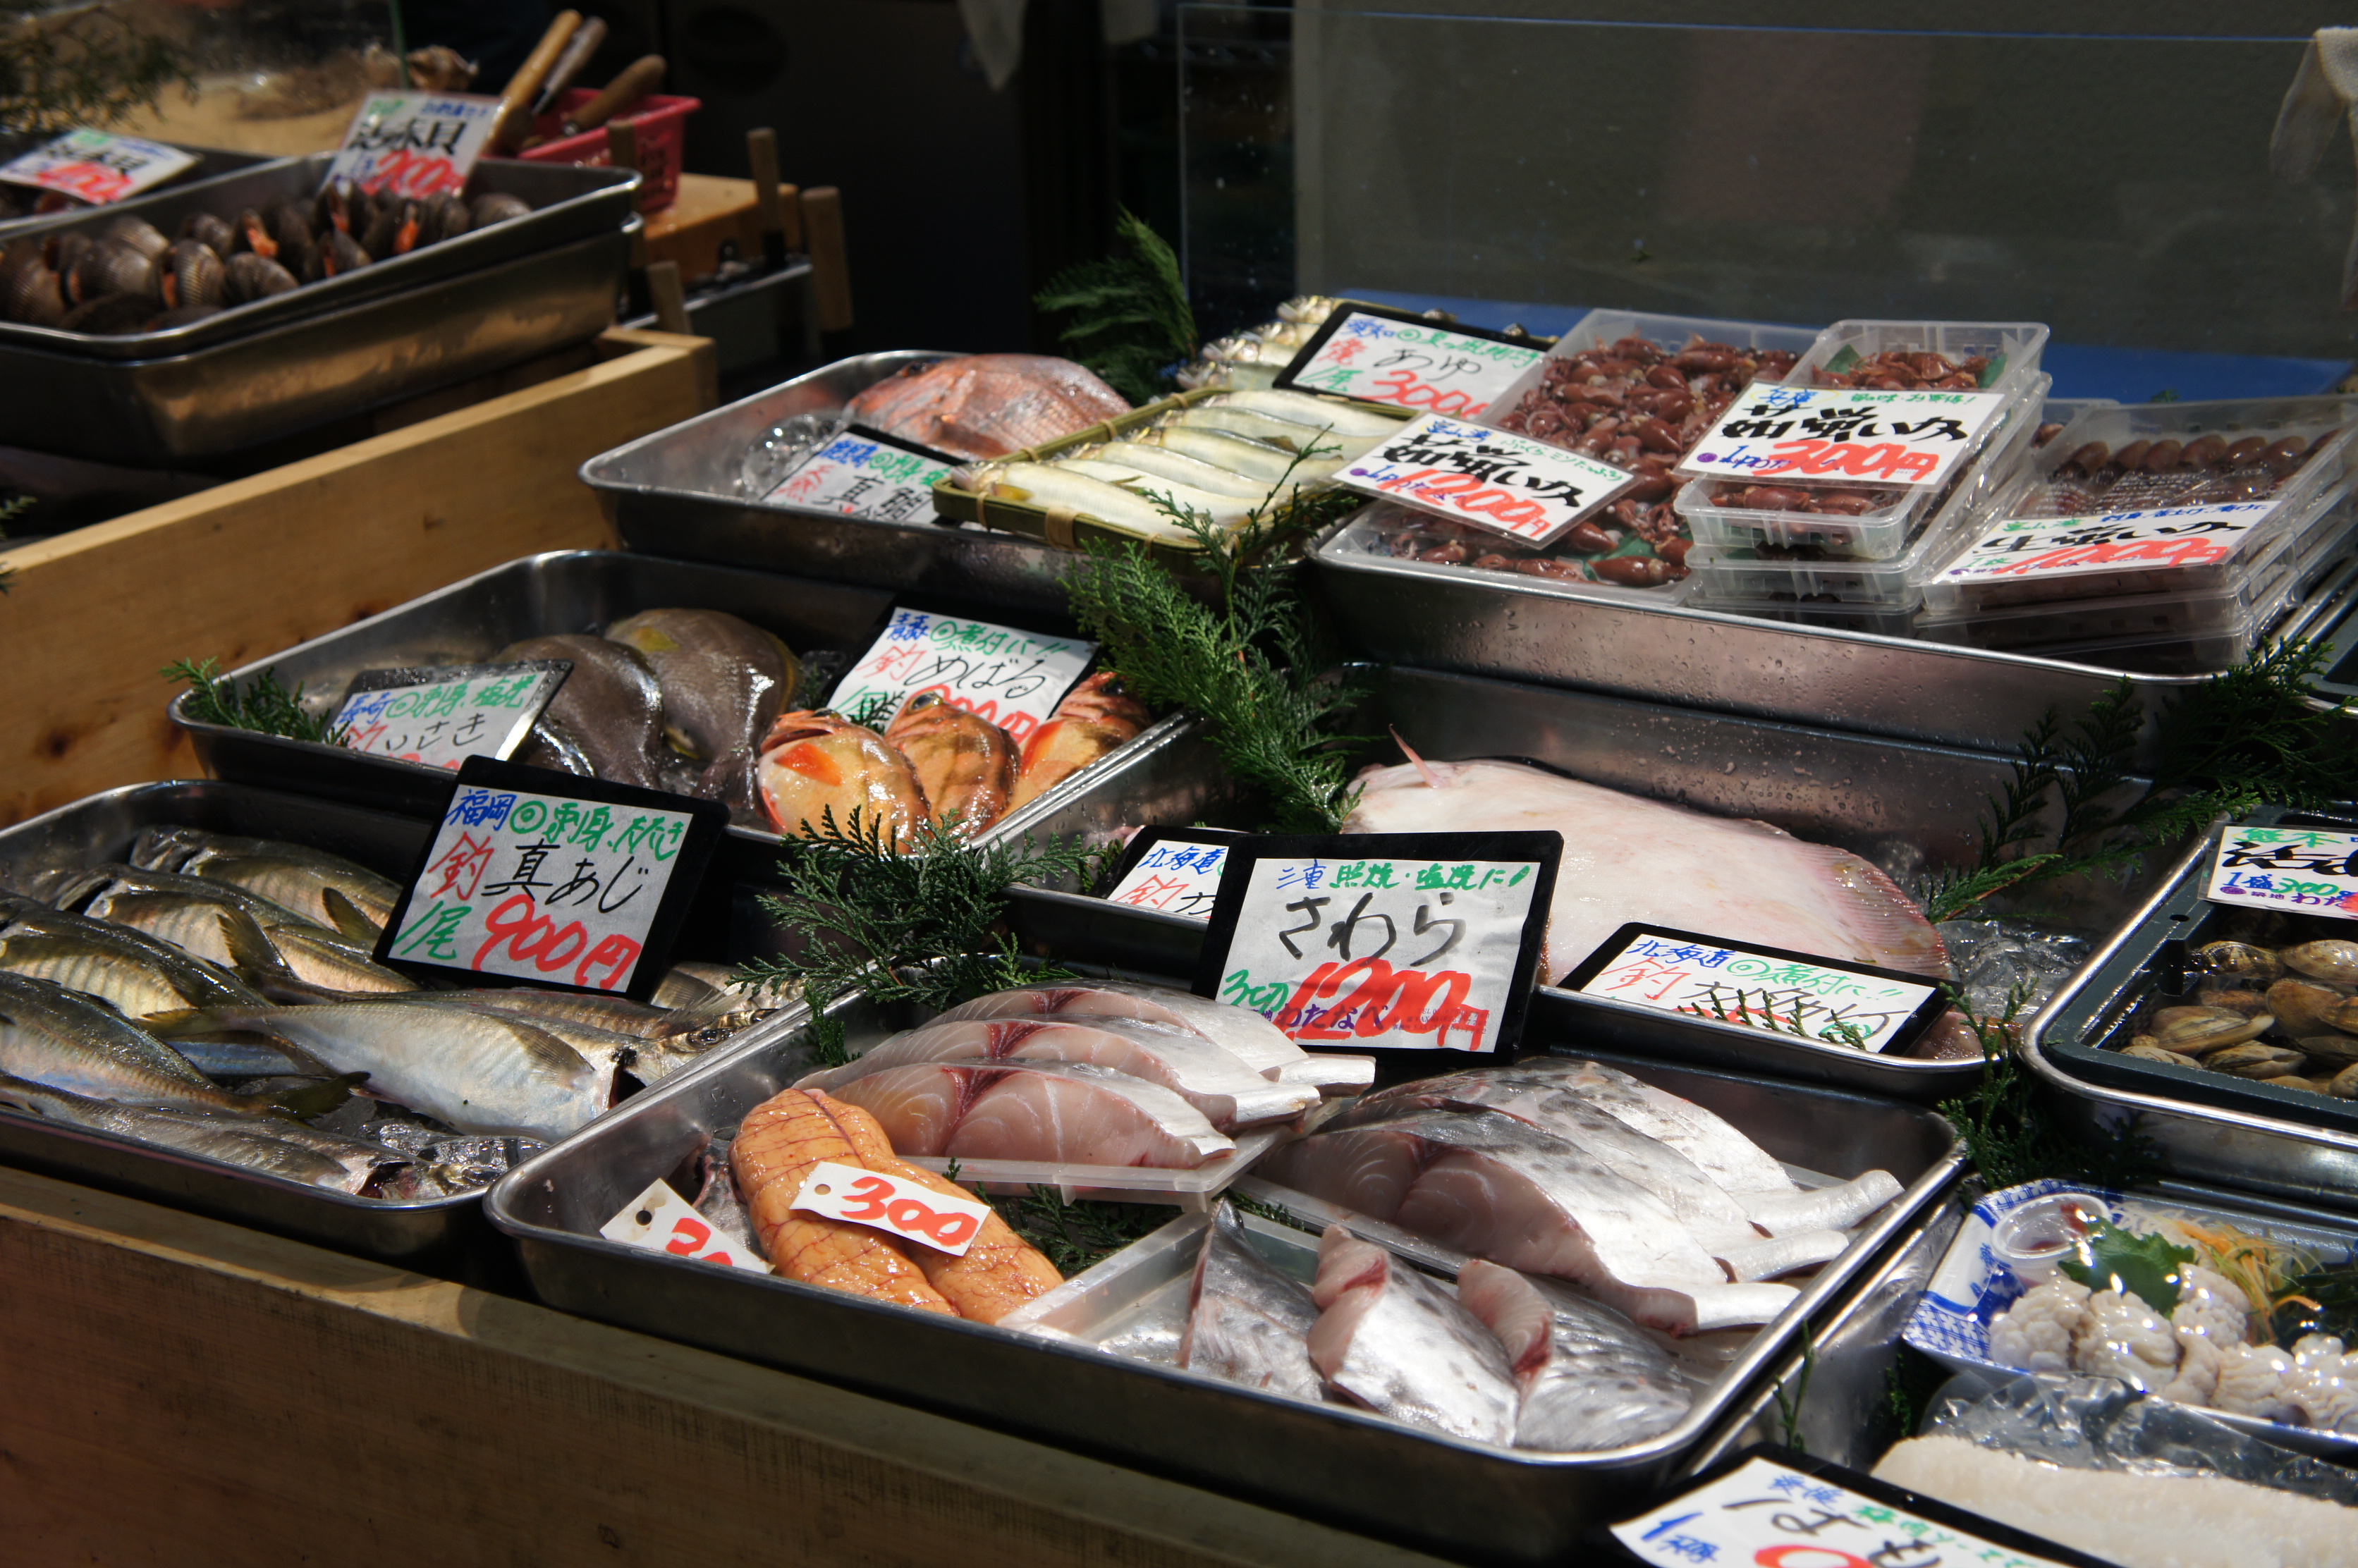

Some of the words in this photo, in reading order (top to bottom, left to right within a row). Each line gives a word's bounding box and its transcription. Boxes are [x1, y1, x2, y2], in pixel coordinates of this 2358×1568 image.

[1374, 348, 1482, 382] あゆ
[1350, 370, 1490, 419] 300
[1752, 439, 1941, 482] 300円
[854, 643, 928, 681] 釣
[903, 655, 1046, 699] めばる
[386, 713, 485, 750] いさき
[444, 789, 517, 831] 福岡
[427, 831, 496, 901] 釣
[480, 838, 649, 914] 真あじ
[1137, 845, 1227, 876] 北海道
[1276, 859, 1327, 890] 三重
[471, 893, 642, 991] 900円
[1278, 891, 1467, 967] さわら
[1627, 938, 1737, 969] 北海道
[1599, 956, 1692, 1000] 釣
[840, 1175, 979, 1247] 300
